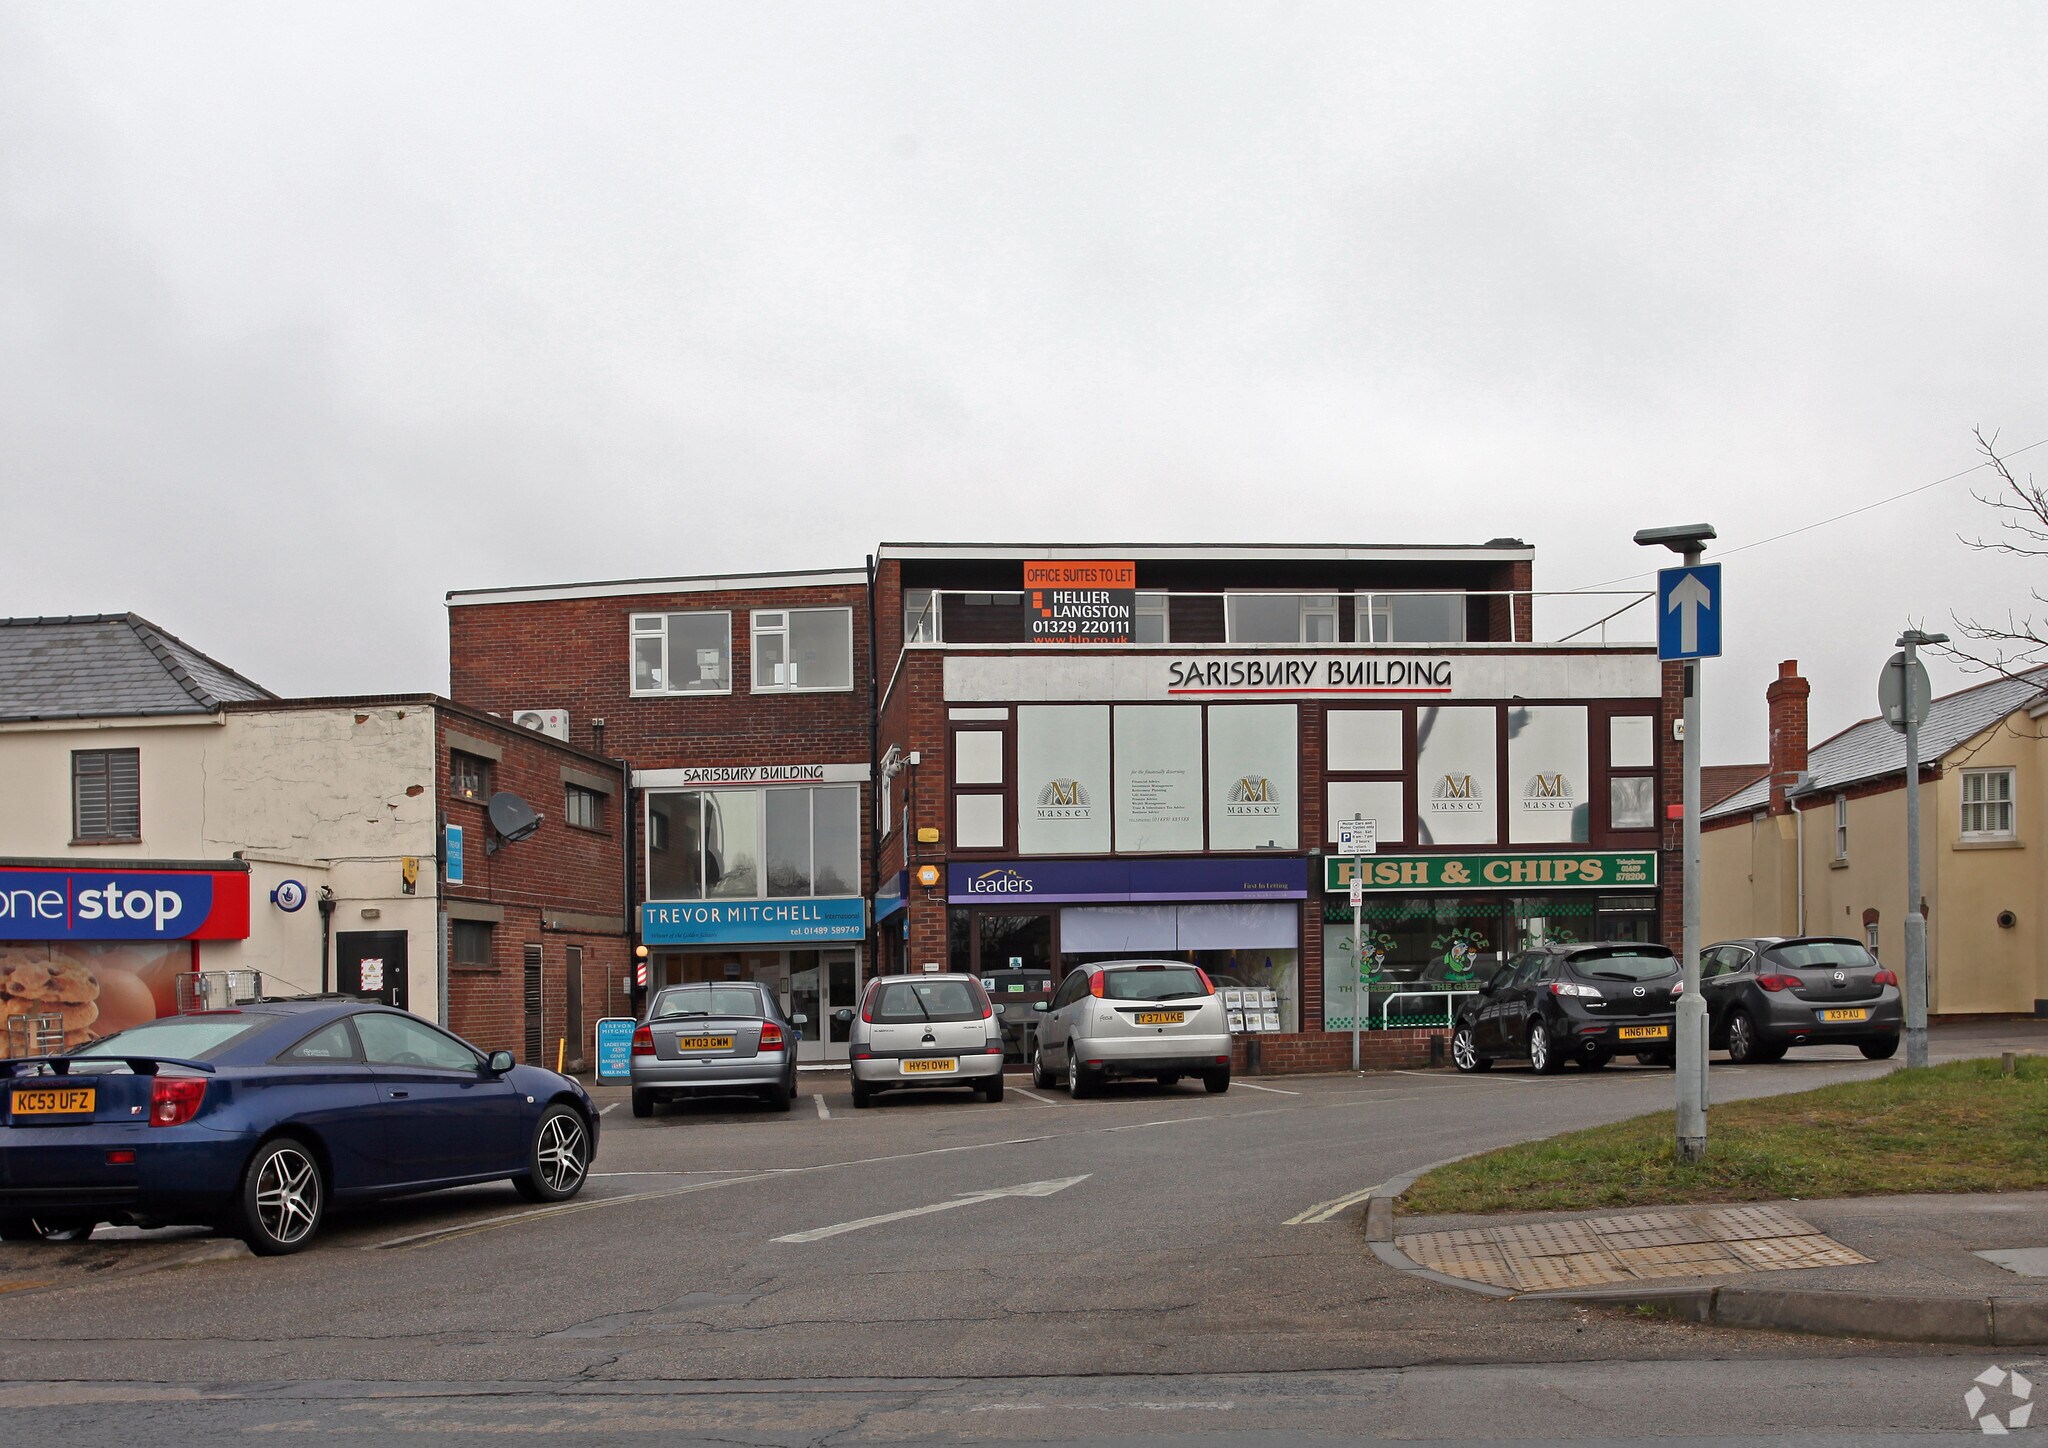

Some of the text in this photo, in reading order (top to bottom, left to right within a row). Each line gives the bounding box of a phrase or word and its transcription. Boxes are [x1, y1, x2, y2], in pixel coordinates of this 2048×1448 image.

[1027, 568, 1132, 582] OFFICE SUITES TO LET
[1053, 591, 1110, 604] HELLIER
[1053, 605, 1129, 618] LANGSTON
[1032, 620, 1129, 633] 01329 220111
[1033, 635, 1128, 644] wwwhlpcouk
[1168, 660, 1452, 687] SARISBURY BUILDING
[684, 765, 823, 782] SARISBURY BUILDING
[1343, 833, 1350, 842] P
[1337, 859, 1604, 885] FISH & CHIPS
[1615, 872, 1647, 881] 578200
[968, 876, 1033, 893] Leaders
[78, 881, 183, 931] stop
[646, 907, 722, 924] TREVOR
[728, 905, 821, 922] MITCHELL
[791, 926, 860, 936] tel. 01489 589749
[1431, 928, 1490, 950] PLAICE
[1431, 983, 1481, 991] THE GREE
[1140, 1012, 1183, 1022] Y371 VKE
[1830, 1009, 1859, 1019] X3 PAU
[1624, 1027, 1662, 1037] HN61 NPA
[684, 1037, 729, 1047] MT03 GWM
[909, 1060, 949, 1071] HY51 OVH
[18, 1091, 89, 1111] KC53 UFZ
